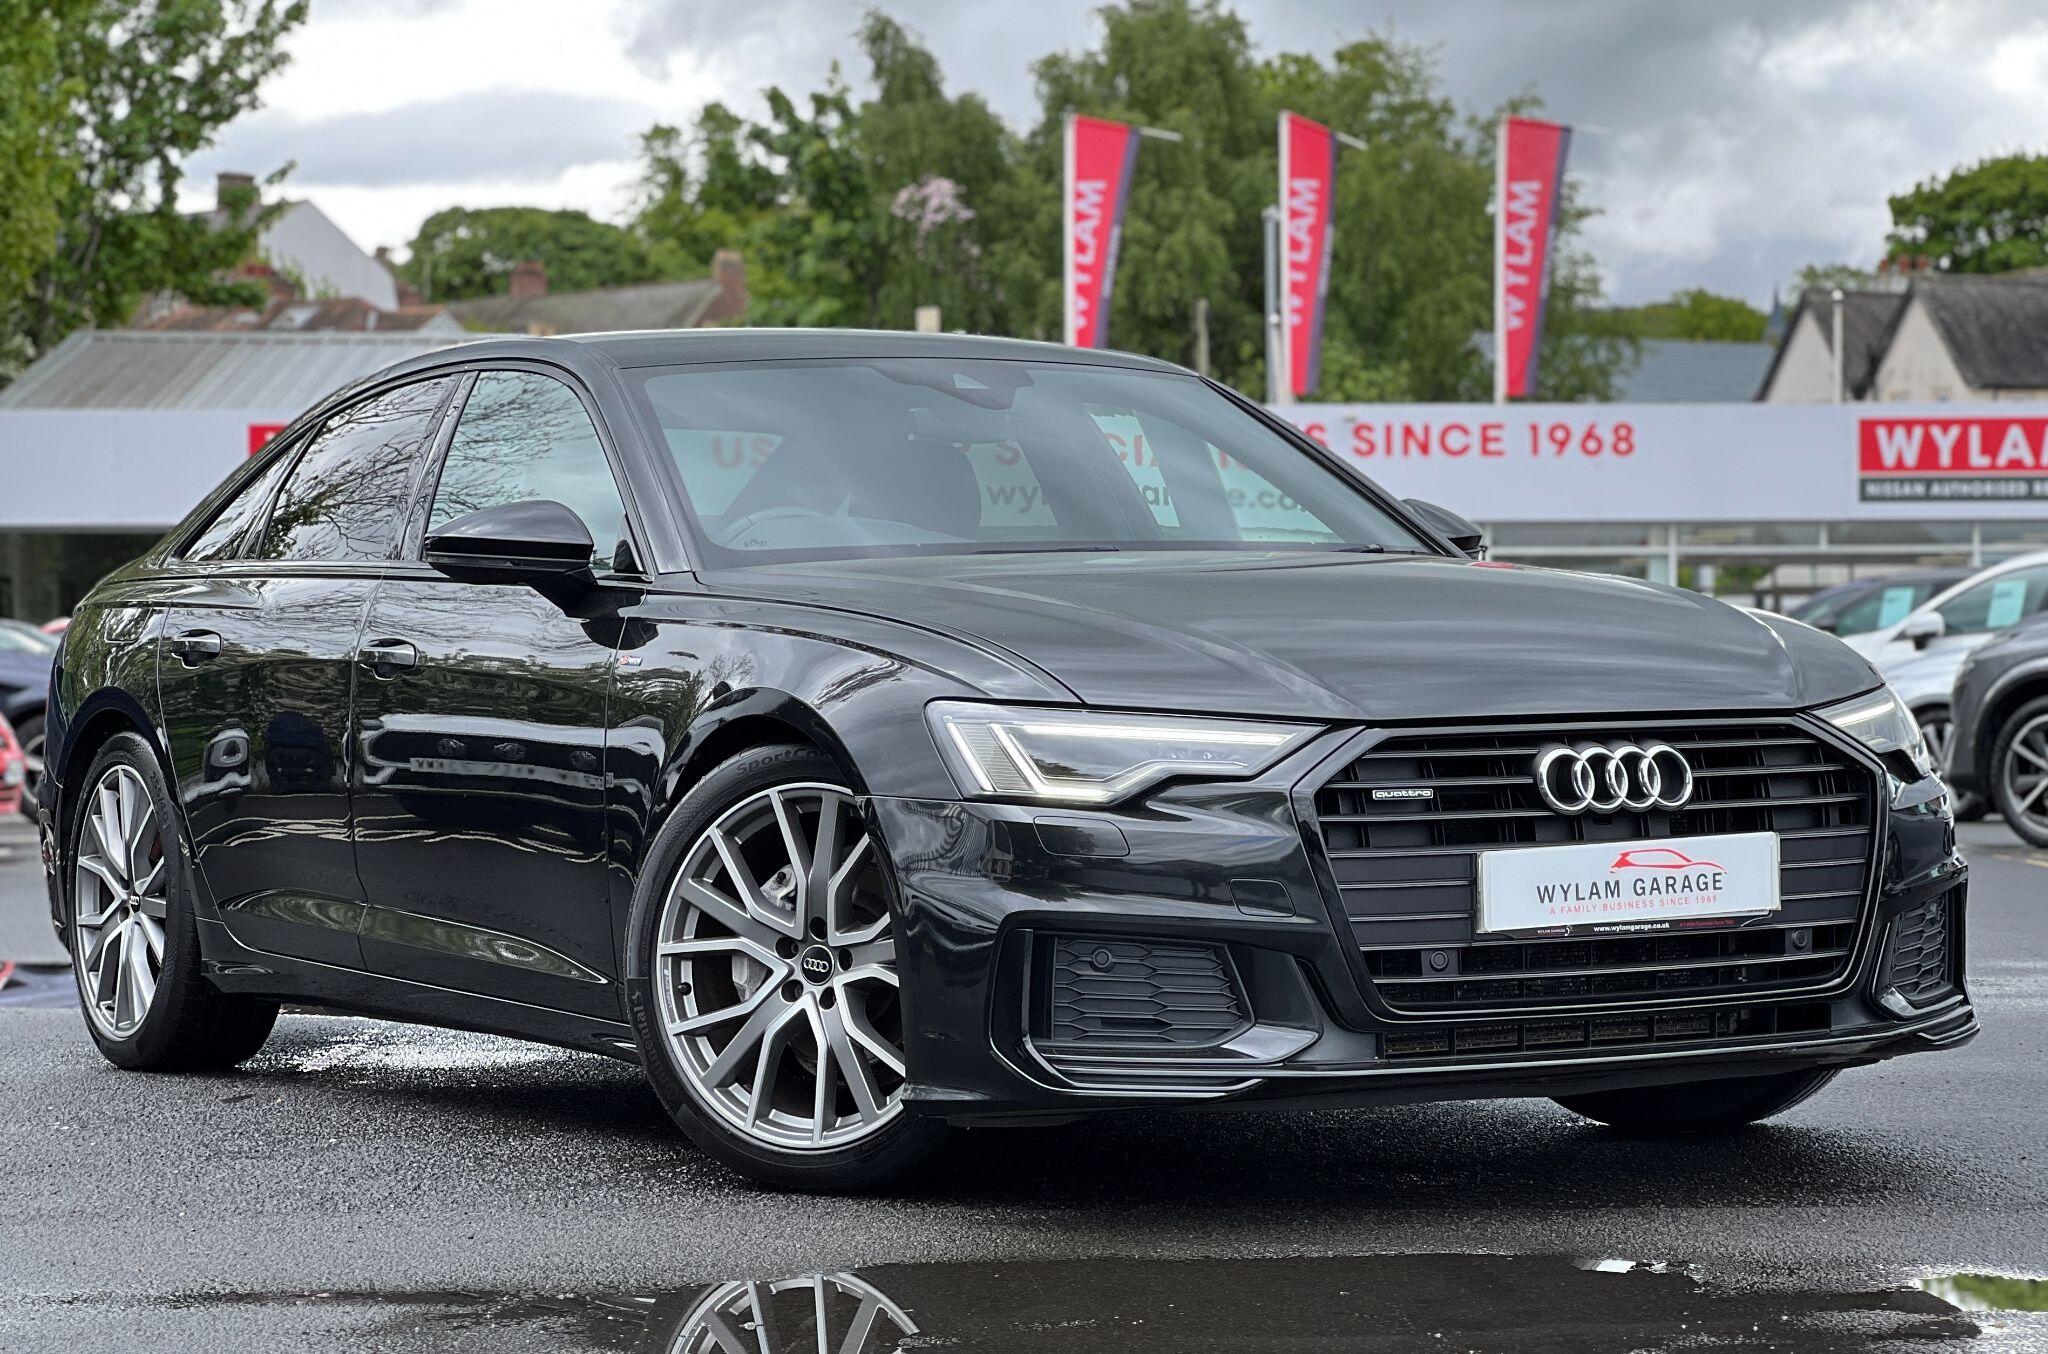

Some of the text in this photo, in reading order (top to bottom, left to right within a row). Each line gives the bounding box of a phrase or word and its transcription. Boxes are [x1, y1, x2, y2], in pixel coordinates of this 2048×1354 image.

[1506, 180, 1542, 330] WYLAM
[1352, 422, 1505, 456] SINCE
[1529, 422, 1634, 456] 1968
[1874, 424, 2048, 468] WYLA
[1376, 790, 1431, 798] quattro
[1536, 872, 1723, 904] WYLAM GARAGE
[1549, 906, 1556, 915] A
[1560, 903, 1598, 915] FAMILY
[1602, 899, 1655, 912] BUSINESS
[1659, 896, 1690, 908] SINCE
[1593, 921, 1670, 933] www.wylamgarage.co.uk
